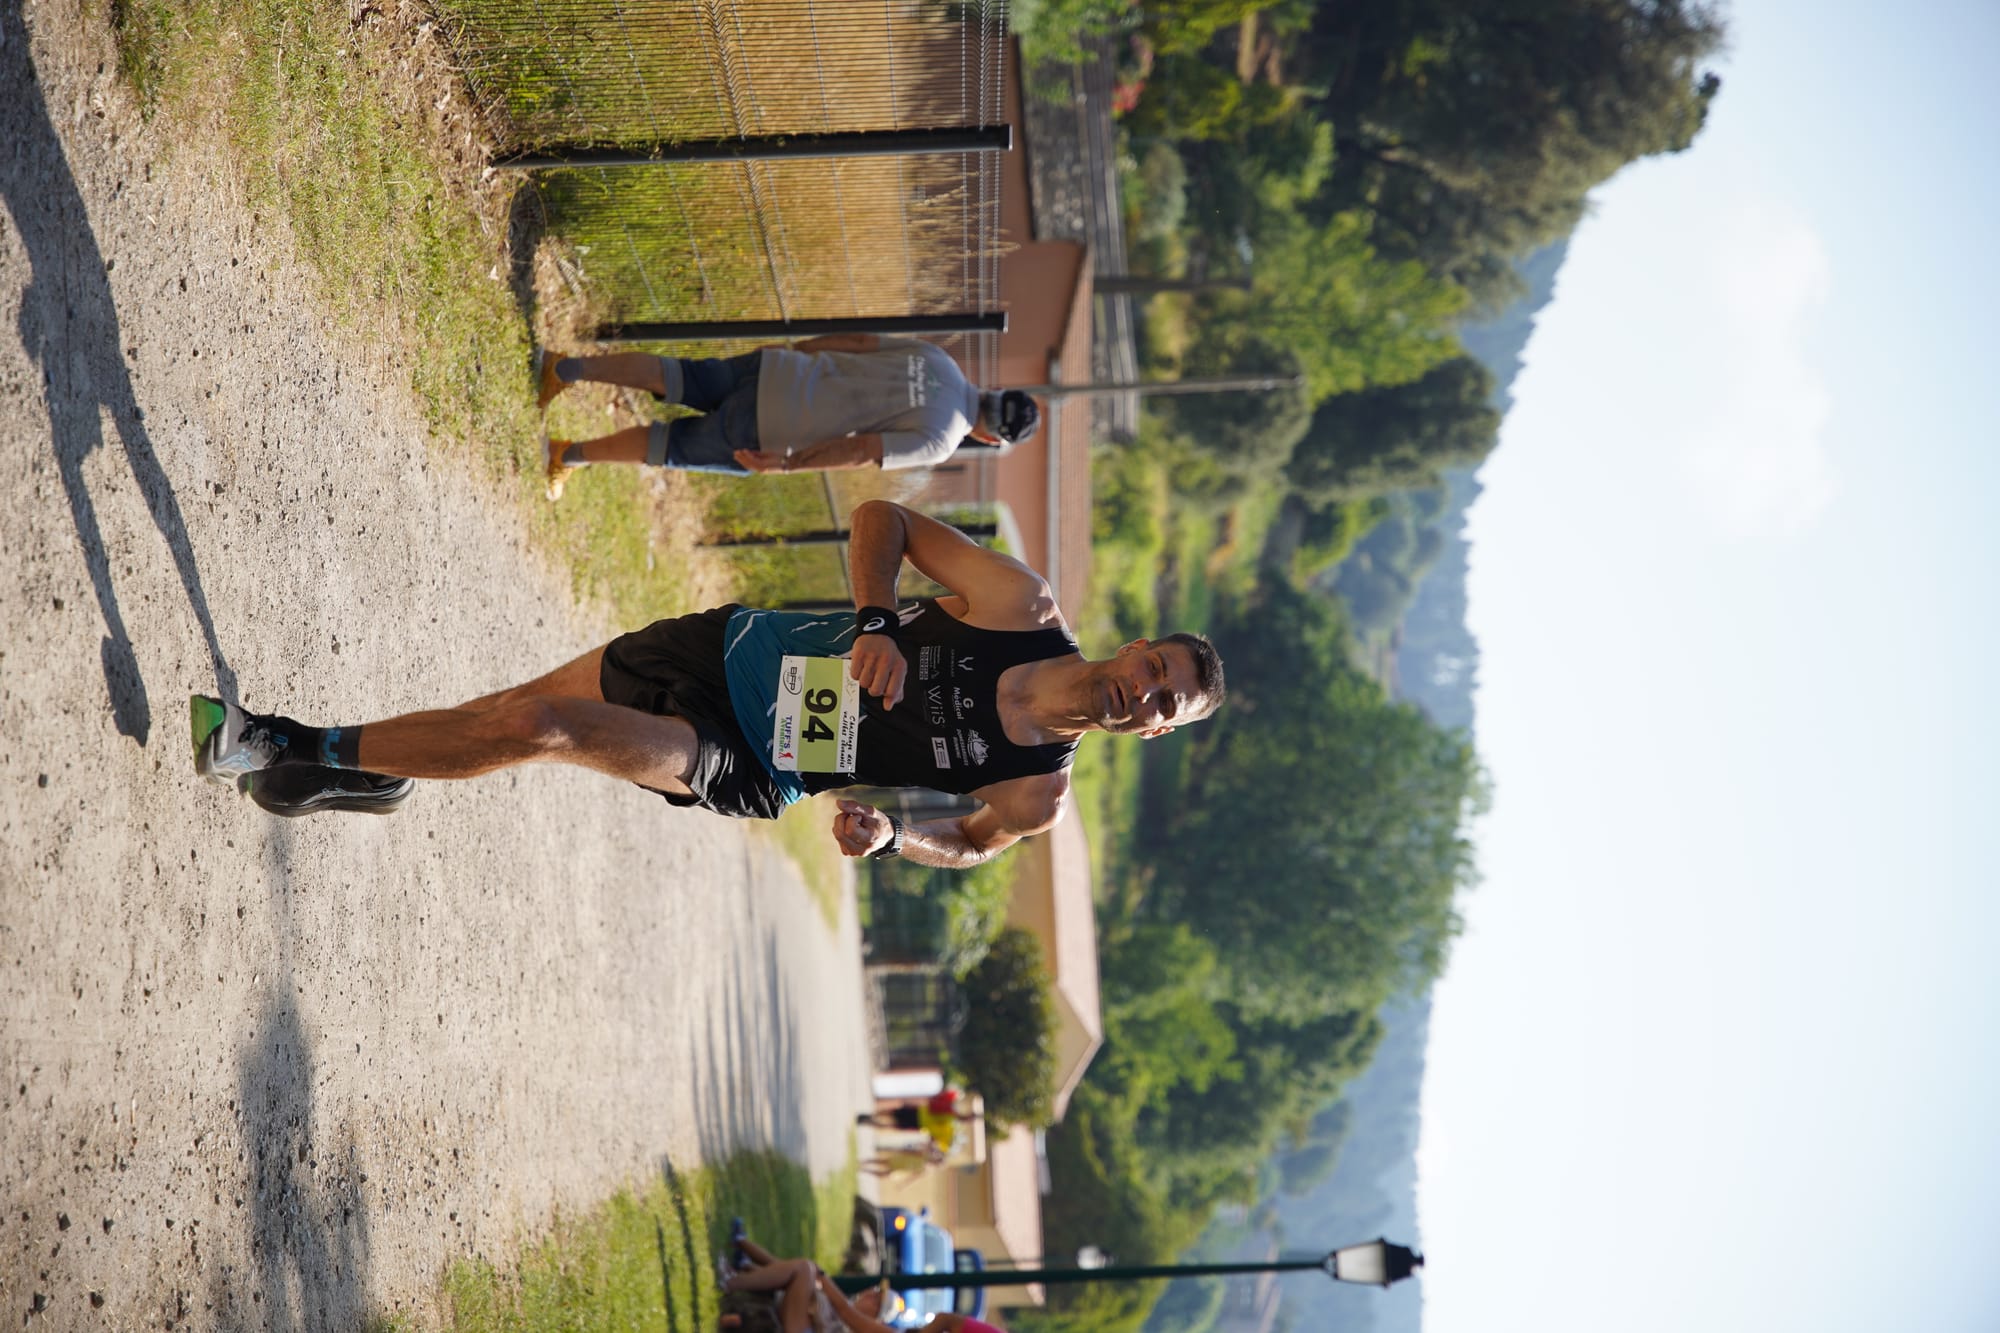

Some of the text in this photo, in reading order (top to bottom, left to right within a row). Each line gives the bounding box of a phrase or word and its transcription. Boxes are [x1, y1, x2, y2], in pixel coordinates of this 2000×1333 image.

[789, 666, 798, 691] BFP
[801, 688, 838, 743] 94
[953, 686, 965, 720] Médical
[962, 697, 974, 710] G
[779, 718, 787, 752] Aventure
[784, 715, 793, 749] TUFF'S
[845, 715, 856, 751] Challenge
